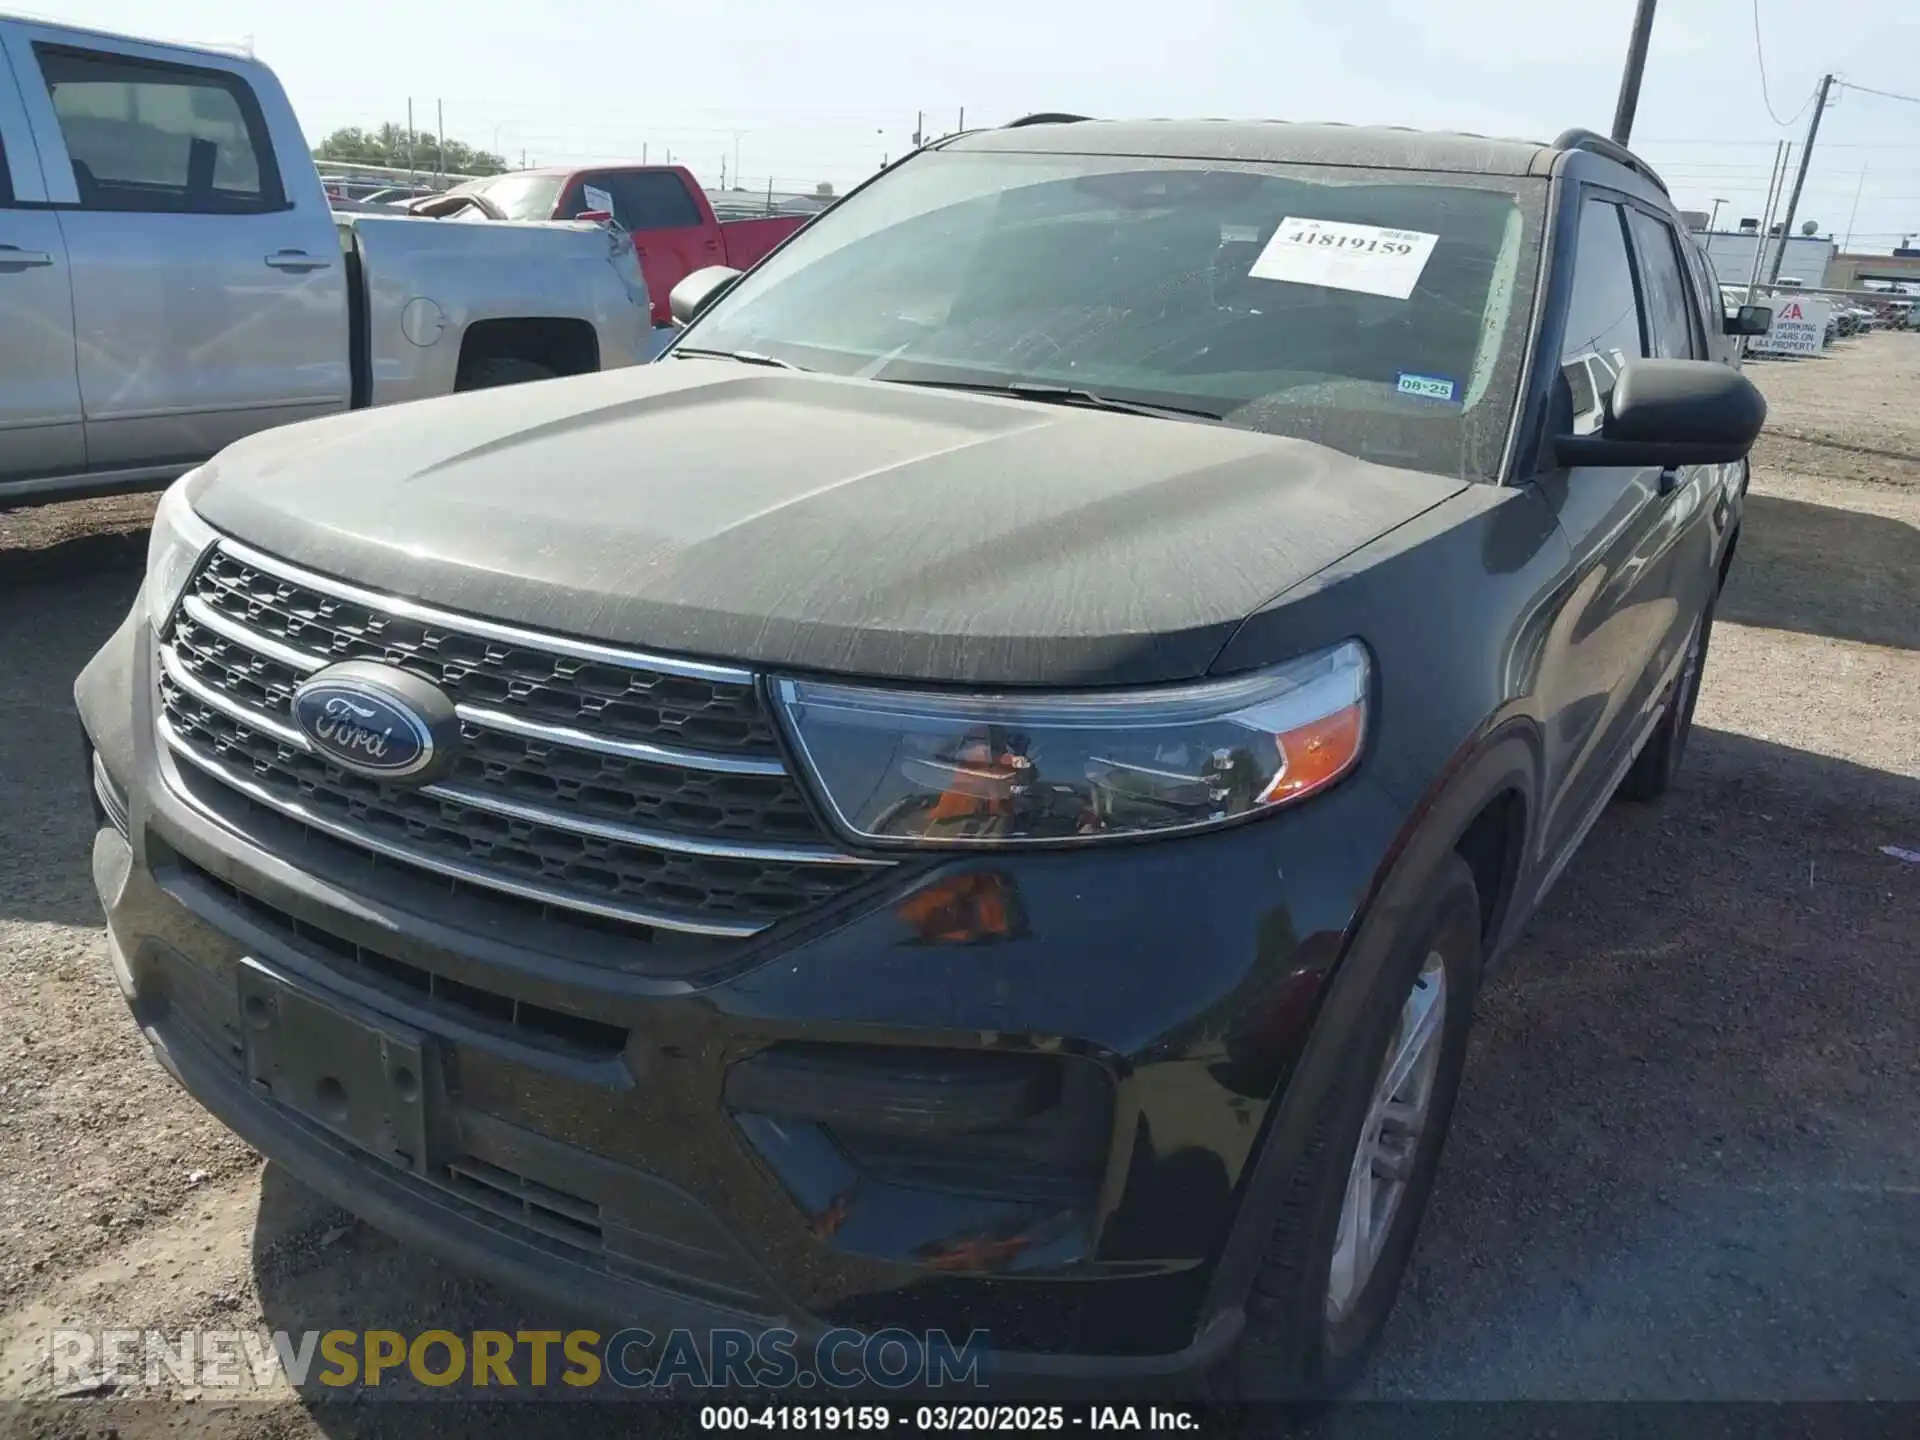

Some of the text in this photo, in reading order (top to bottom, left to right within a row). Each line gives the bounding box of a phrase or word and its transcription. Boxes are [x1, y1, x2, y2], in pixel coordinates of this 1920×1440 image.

[1289, 231, 1413, 256] 41819159
[1776, 322, 1817, 333] WORKING
[1775, 331, 1815, 342] CARS ON
[1771, 340, 1817, 352] PROPERTY
[1401, 379, 1449, 395] 08-25
[315, 697, 393, 759] Ford
